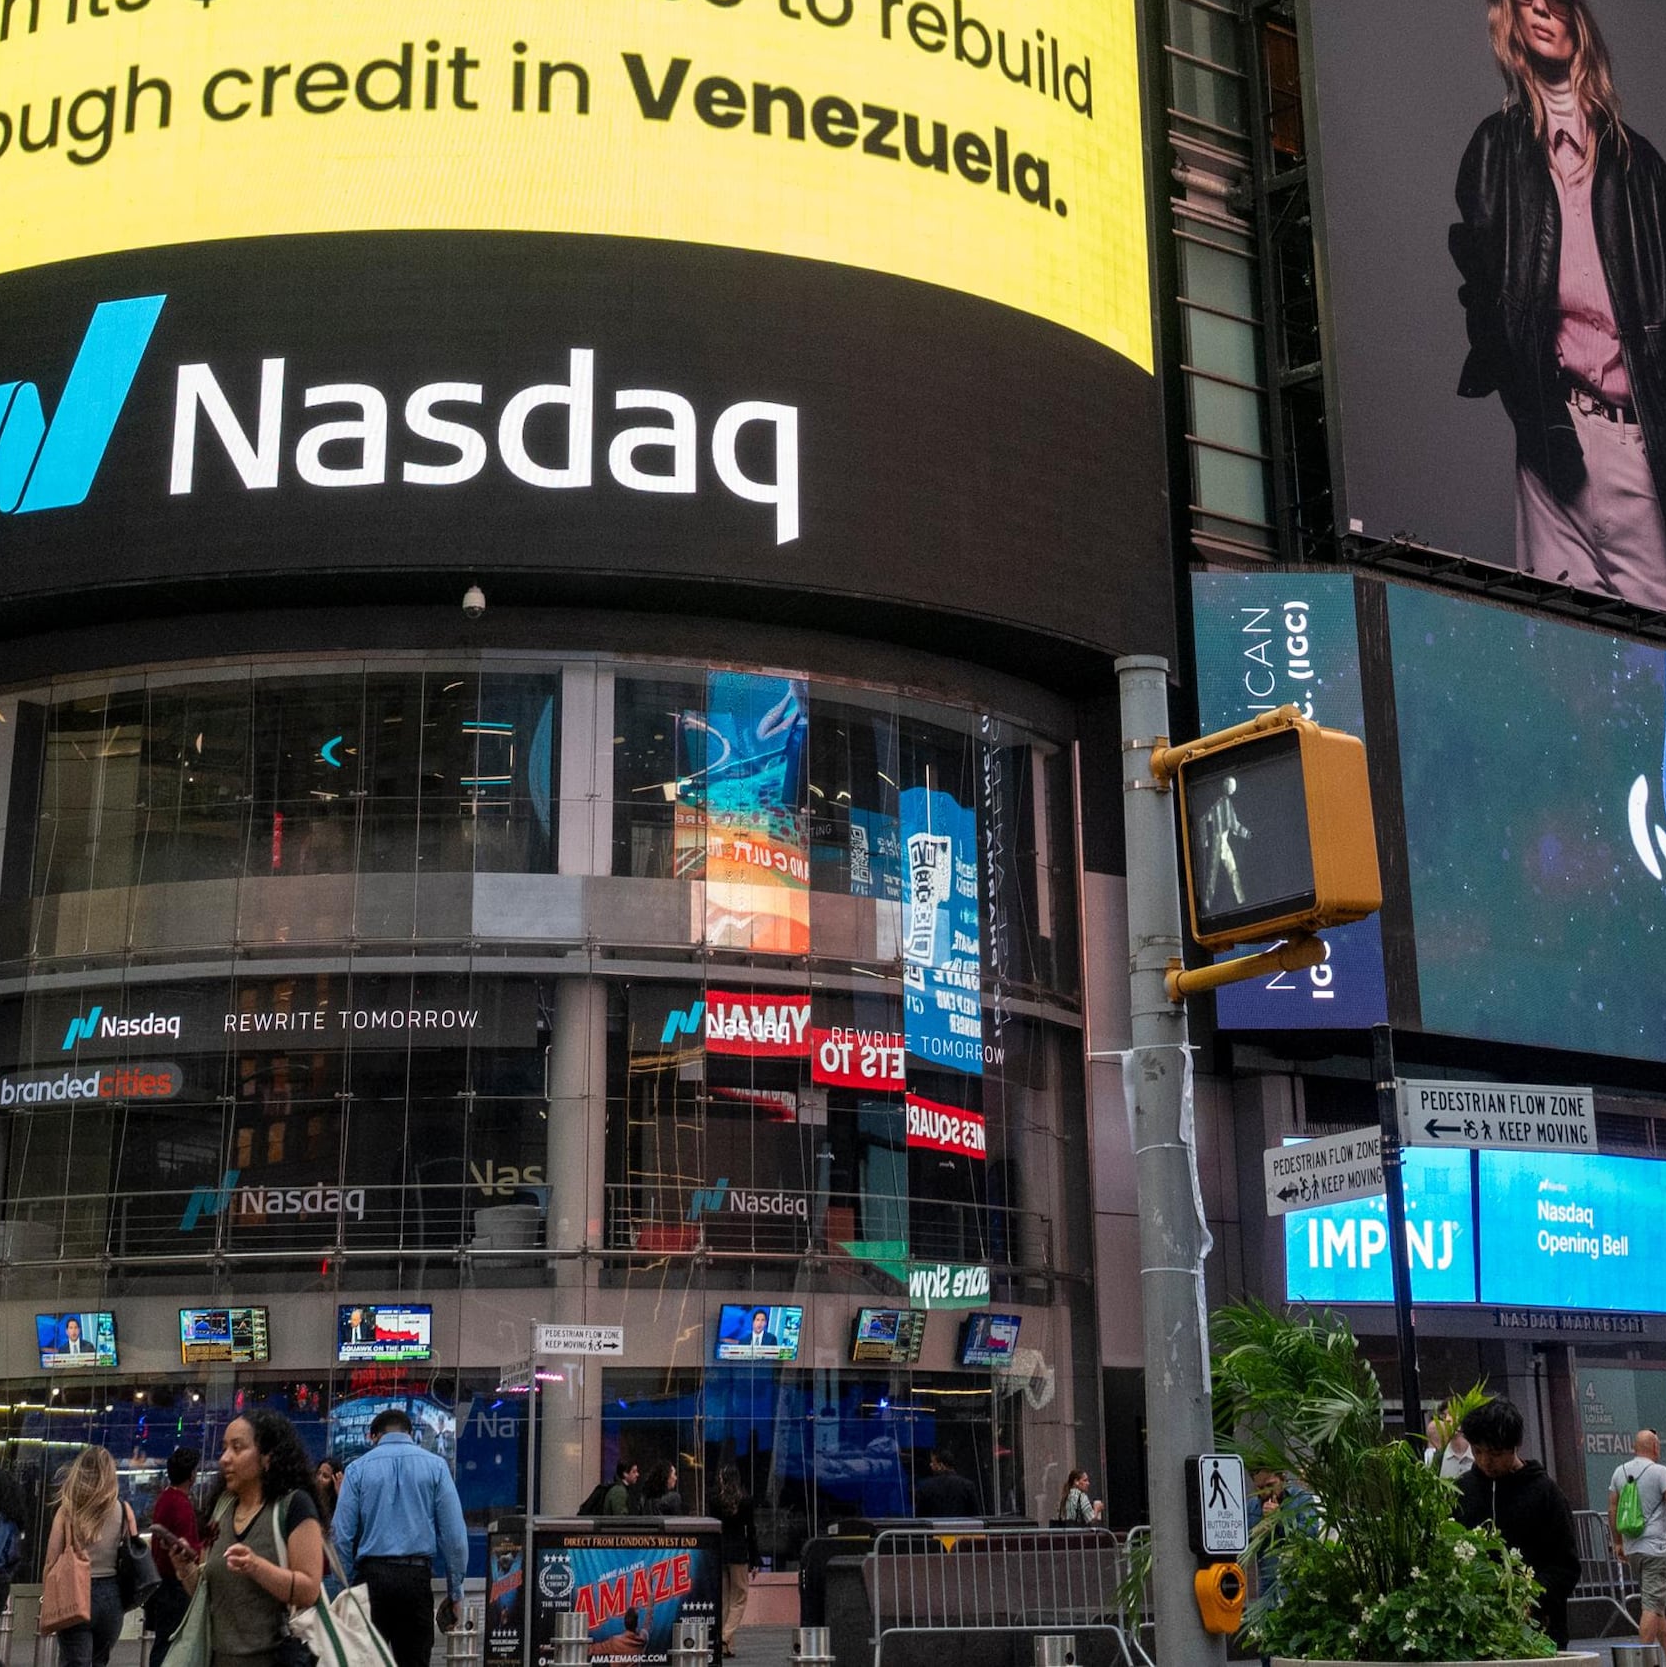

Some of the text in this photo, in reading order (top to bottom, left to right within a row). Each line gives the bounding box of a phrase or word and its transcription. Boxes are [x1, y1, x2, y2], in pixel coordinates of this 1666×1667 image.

[202, 41, 479, 124] credit
[511, 42, 592, 117] in
[621, 51, 1070, 221] Venezuela.
[169, 348, 800, 545] Nasdaq
[1241, 607, 1277, 710] ICAN
[100, 1012, 182, 1039] Nasdaq
[224, 1008, 480, 1033] REWRITE TOMORROW
[706, 1013, 791, 1045] Nasdaq
[831, 1026, 1005, 1065] REWRITE TOMORROW
[0, 1065, 173, 1106] brandedcities
[1420, 1089, 1586, 1118] PEDESTRIAN FLOW ZONE
[1499, 1123, 1588, 1145] KEEP MOVING
[1273, 1138, 1381, 1177] PEDESTRIAN FLOW ZONE
[1321, 1165, 1383, 1194] KEEP MOVING
[240, 1184, 365, 1218] Nasdaq
[730, 1190, 809, 1218] Nasdaq
[1537, 1199, 1594, 1229] Nasdaq
[1308, 1217, 1454, 1270] IMPNJ
[1537, 1230, 1629, 1260] Opening Bell
[545, 1329, 620, 1340] PEDESTRIAN FLOW ZONE
[1498, 1312, 1649, 1334] NASDAQ MARKETSITE
[545, 1340, 587, 1350] KEEP MOVING
[1583, 1403, 1604, 1414] TIMES
[1584, 1414, 1614, 1425] SQUARE
[1586, 1434, 1636, 1454] RETAIL
[1207, 1520, 1243, 1529] BUTTON FOR
[1217, 1510, 1233, 1519] PUSH
[563, 1536, 698, 1547] DIRECT FROM LONDON'S WEST END
[1214, 1529, 1238, 1539] AUDIBLE
[541, 1600, 554, 1608] THE
[574, 1552, 693, 1631] AMAZE
[590, 1653, 668, 1665] AMAZEMAGIC.COM
